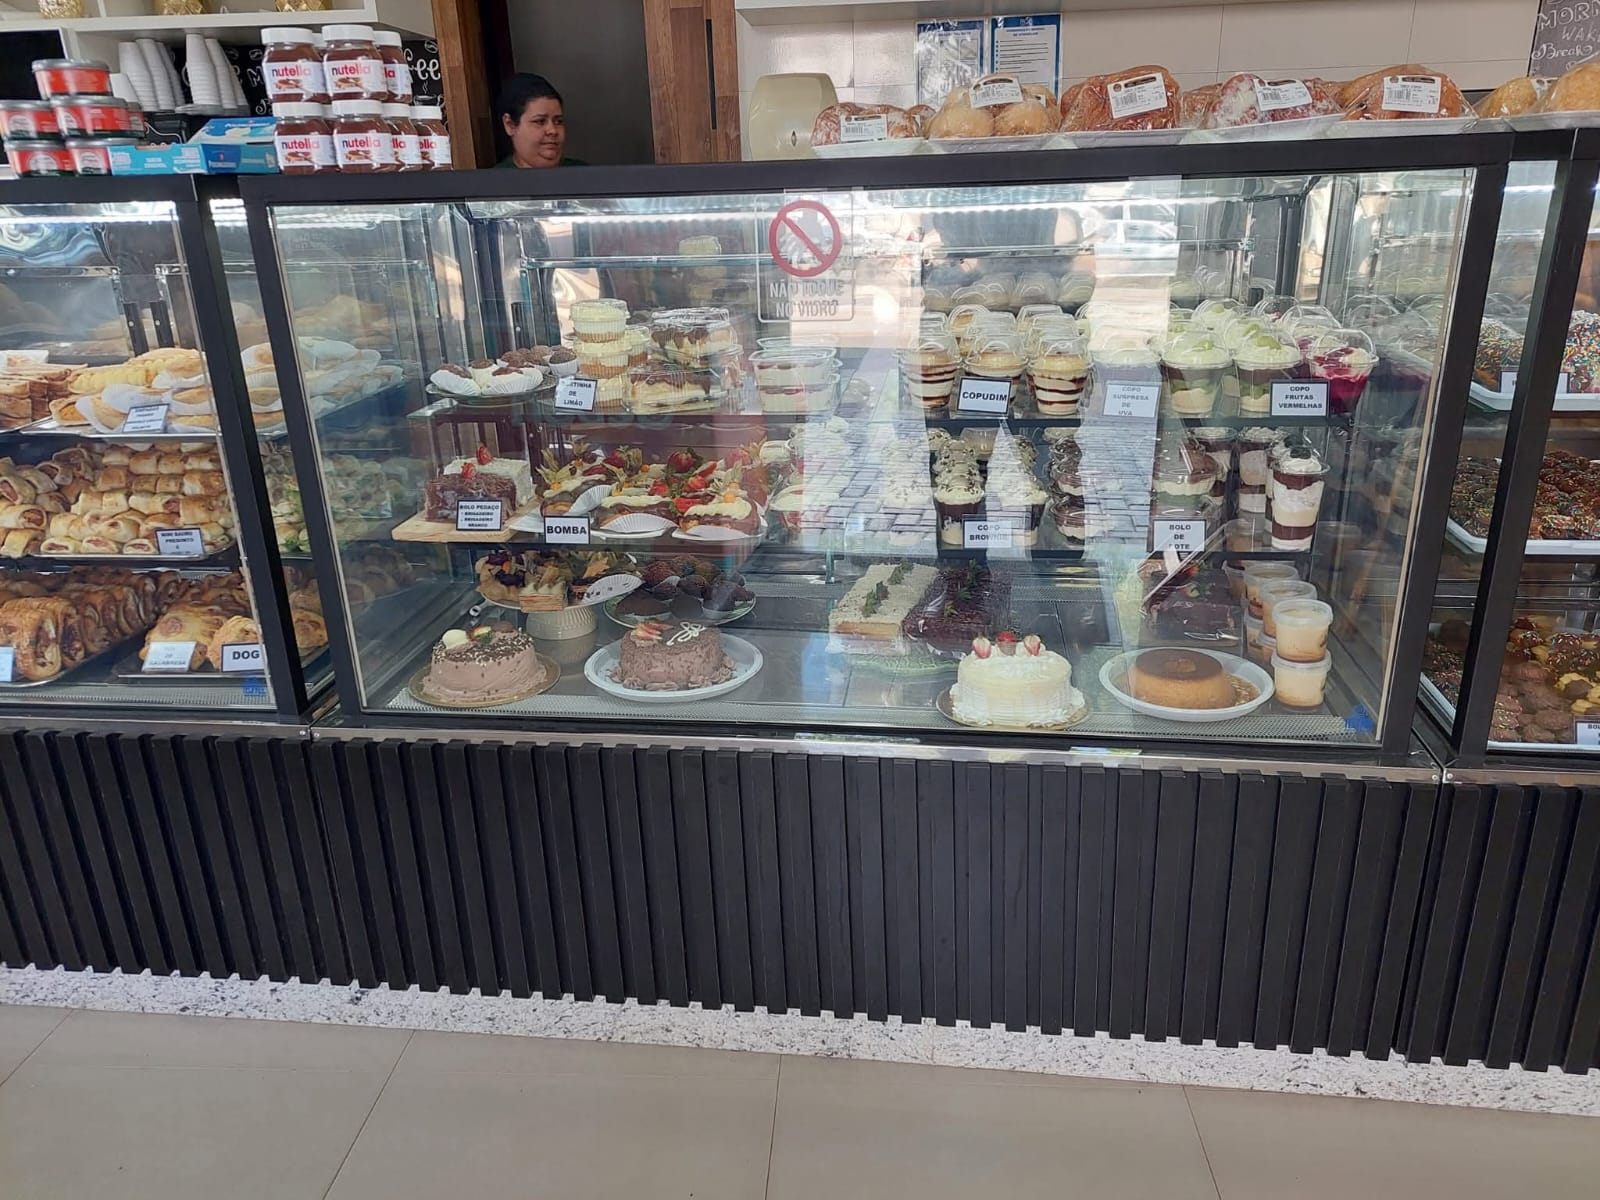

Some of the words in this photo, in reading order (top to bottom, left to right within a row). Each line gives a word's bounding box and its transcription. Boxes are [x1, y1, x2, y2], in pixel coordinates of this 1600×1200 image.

[1561, 26, 1600, 42] WAK
[271, 64, 311, 78] nutella
[331, 63, 371, 76] nutella
[281, 137, 320, 150] nutella
[342, 136, 381, 149] nutella
[962, 392, 1007, 401] COPUDIM
[546, 525, 587, 535] BOMBA
[232, 650, 260, 660] DOG
